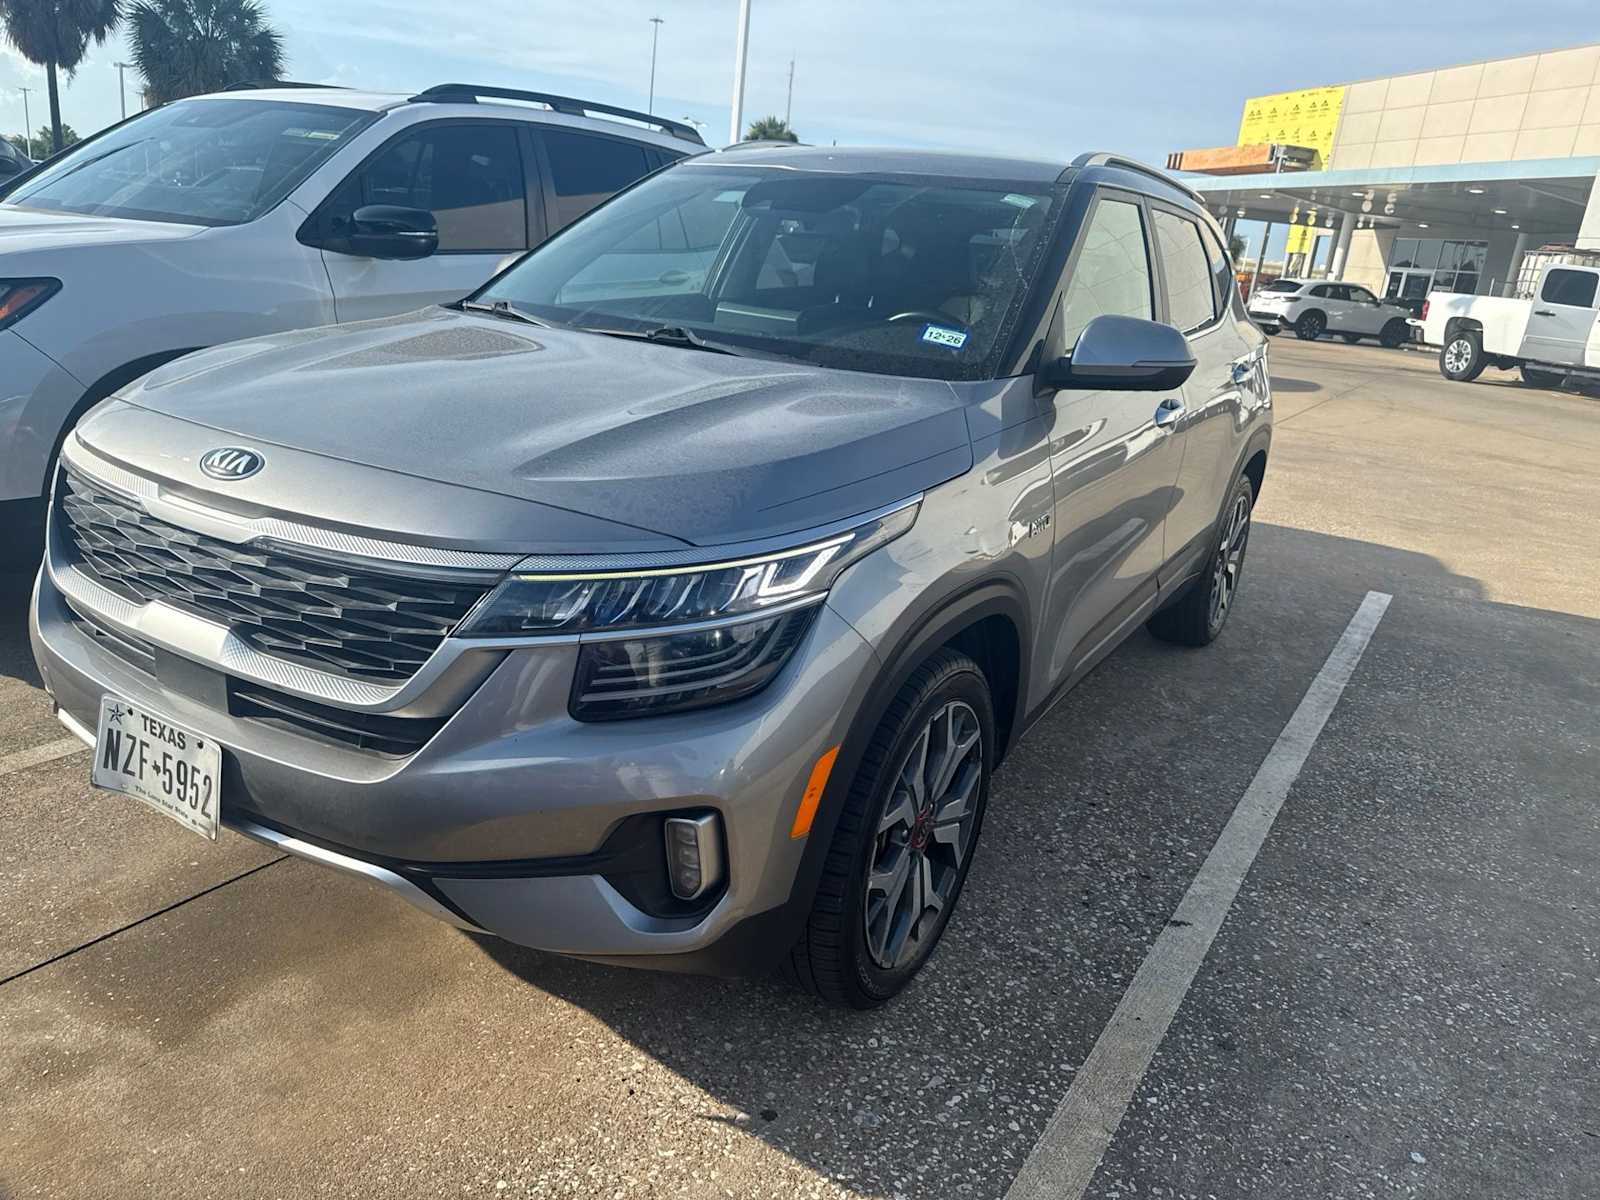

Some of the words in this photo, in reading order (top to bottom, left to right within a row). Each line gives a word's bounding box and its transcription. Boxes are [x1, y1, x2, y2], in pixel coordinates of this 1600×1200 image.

[206, 449, 252, 474] KIA
[141, 714, 186, 750] TEXAS
[103, 728, 150, 781] NZF
[162, 751, 212, 819] 5952
